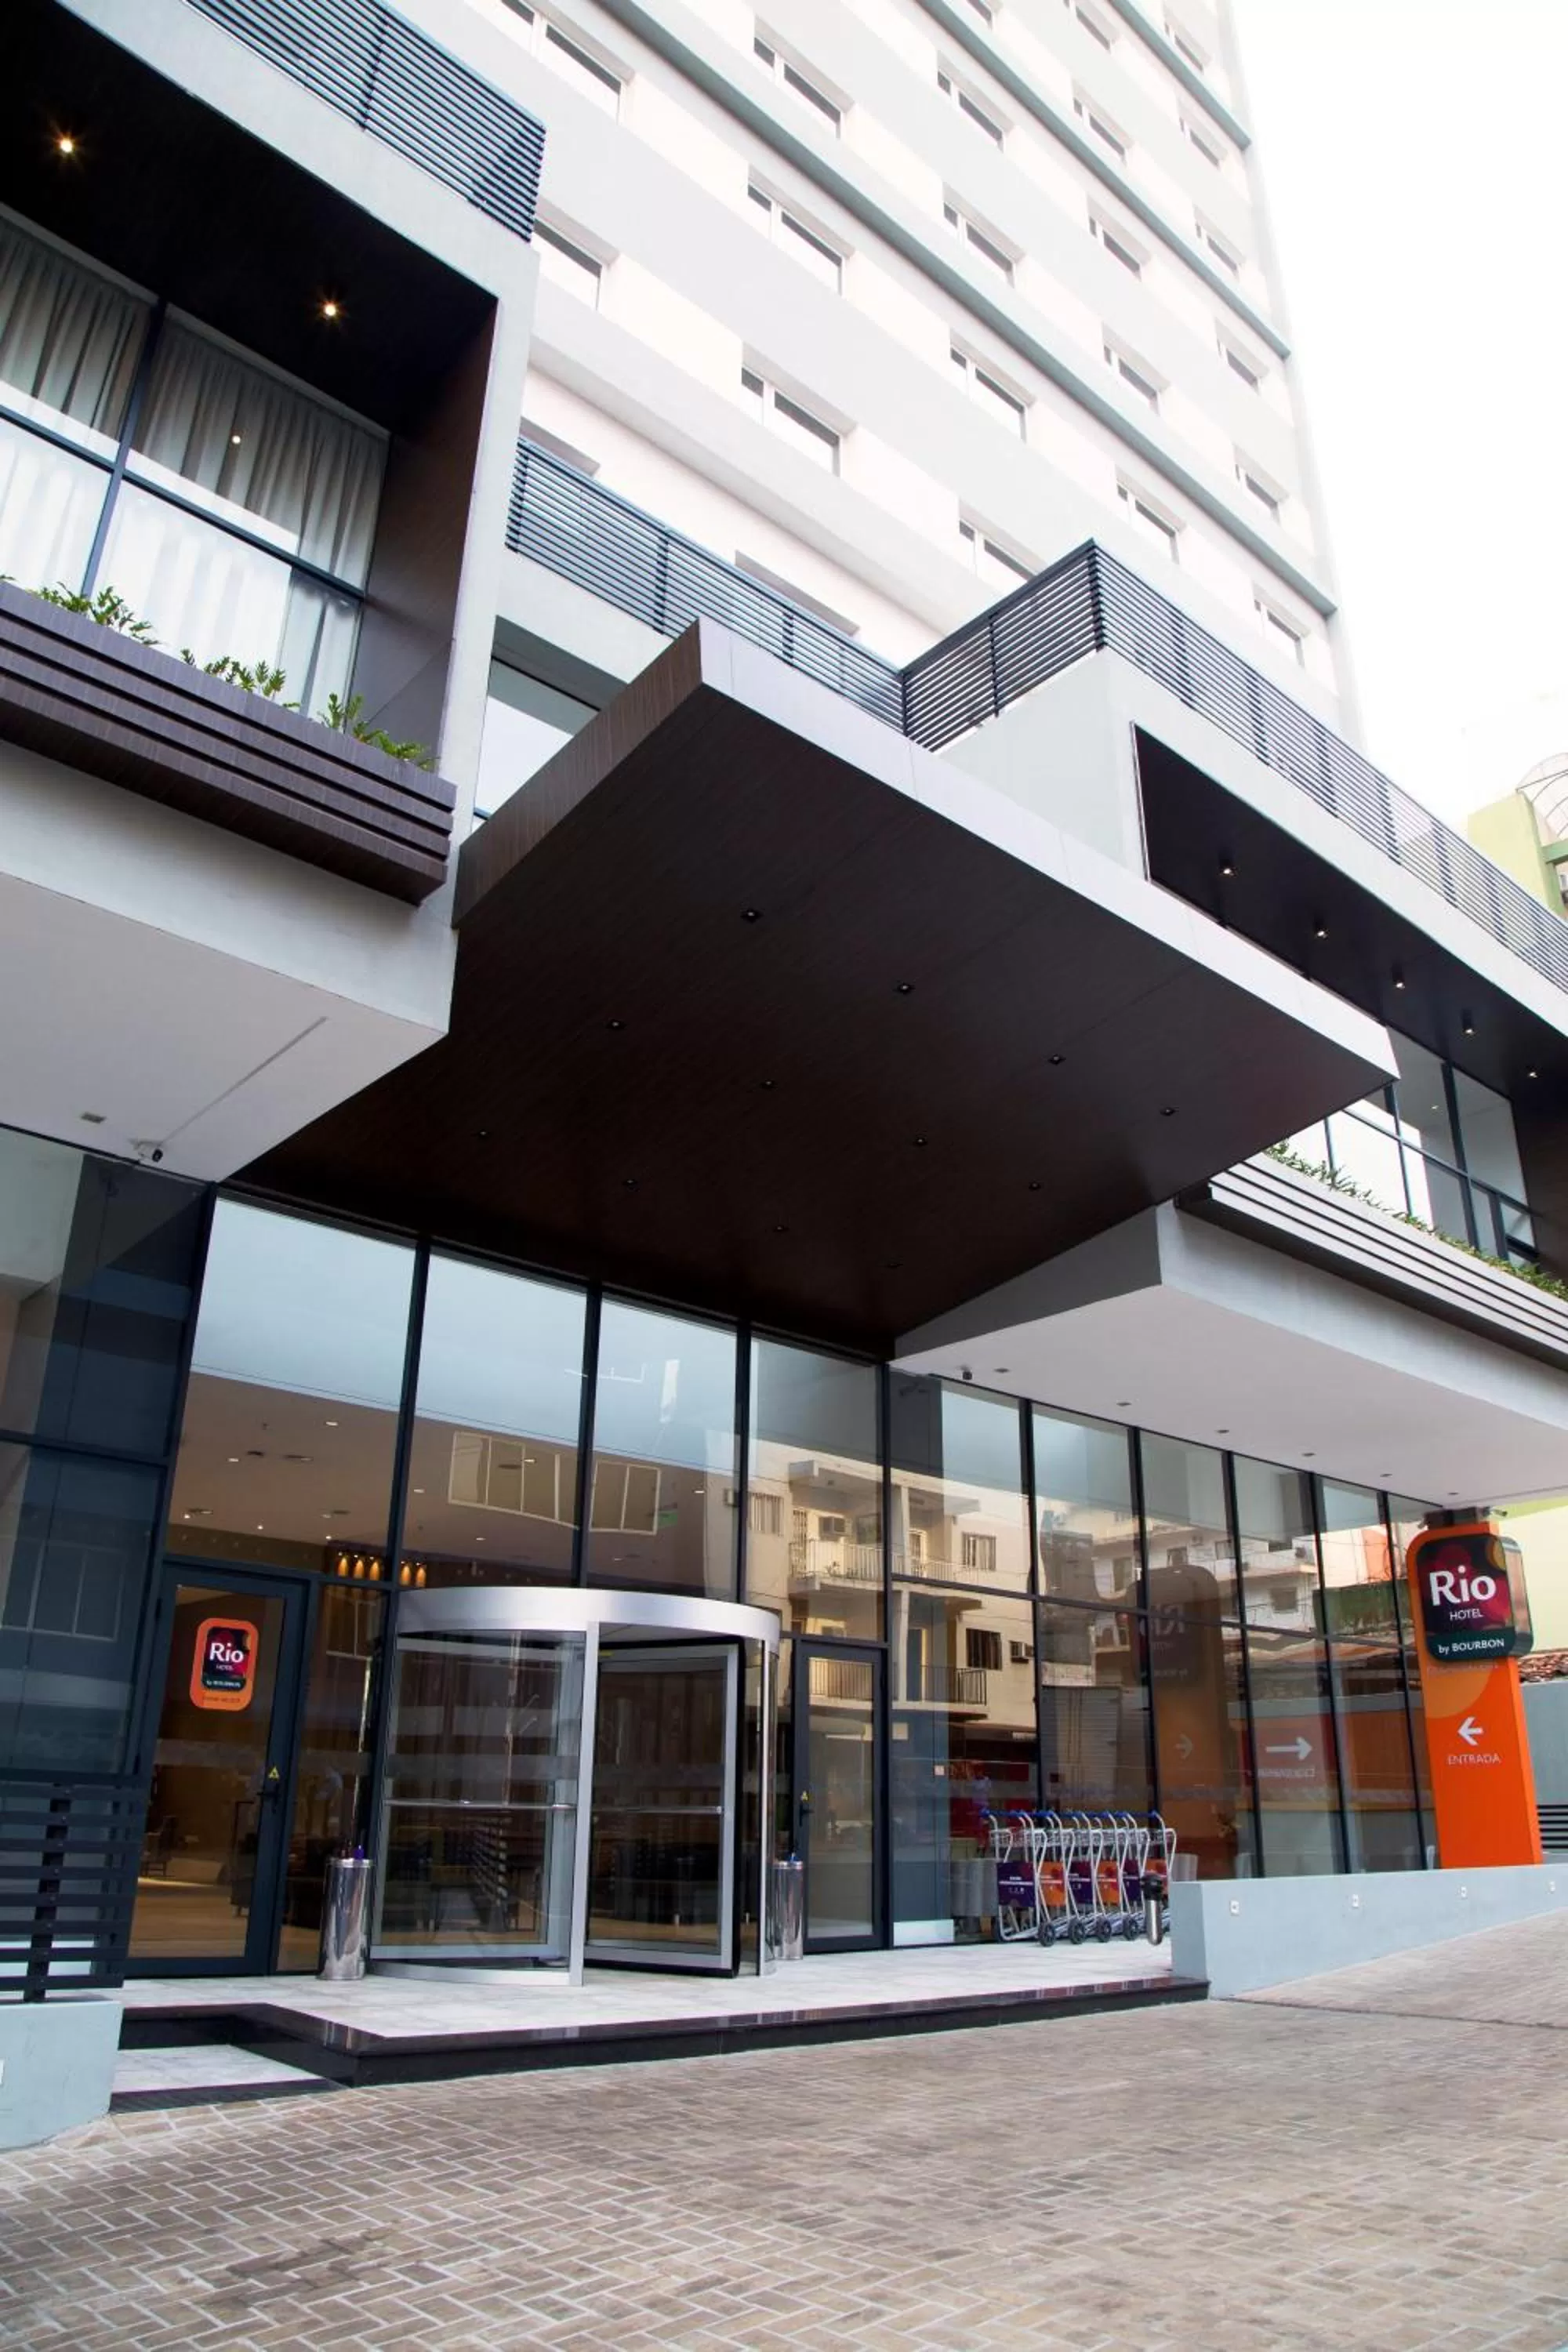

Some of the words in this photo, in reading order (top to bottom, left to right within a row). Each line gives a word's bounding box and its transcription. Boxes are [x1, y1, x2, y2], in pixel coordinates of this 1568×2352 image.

[1429, 1565, 1496, 1606] Rio
[1450, 1608, 1483, 1621] HOTEL
[209, 1642, 244, 1663] Rio
[1438, 1644, 1450, 1655] by
[1451, 1638, 1504, 1652] BOURBON
[1447, 1752, 1501, 1765] ENTRADA
